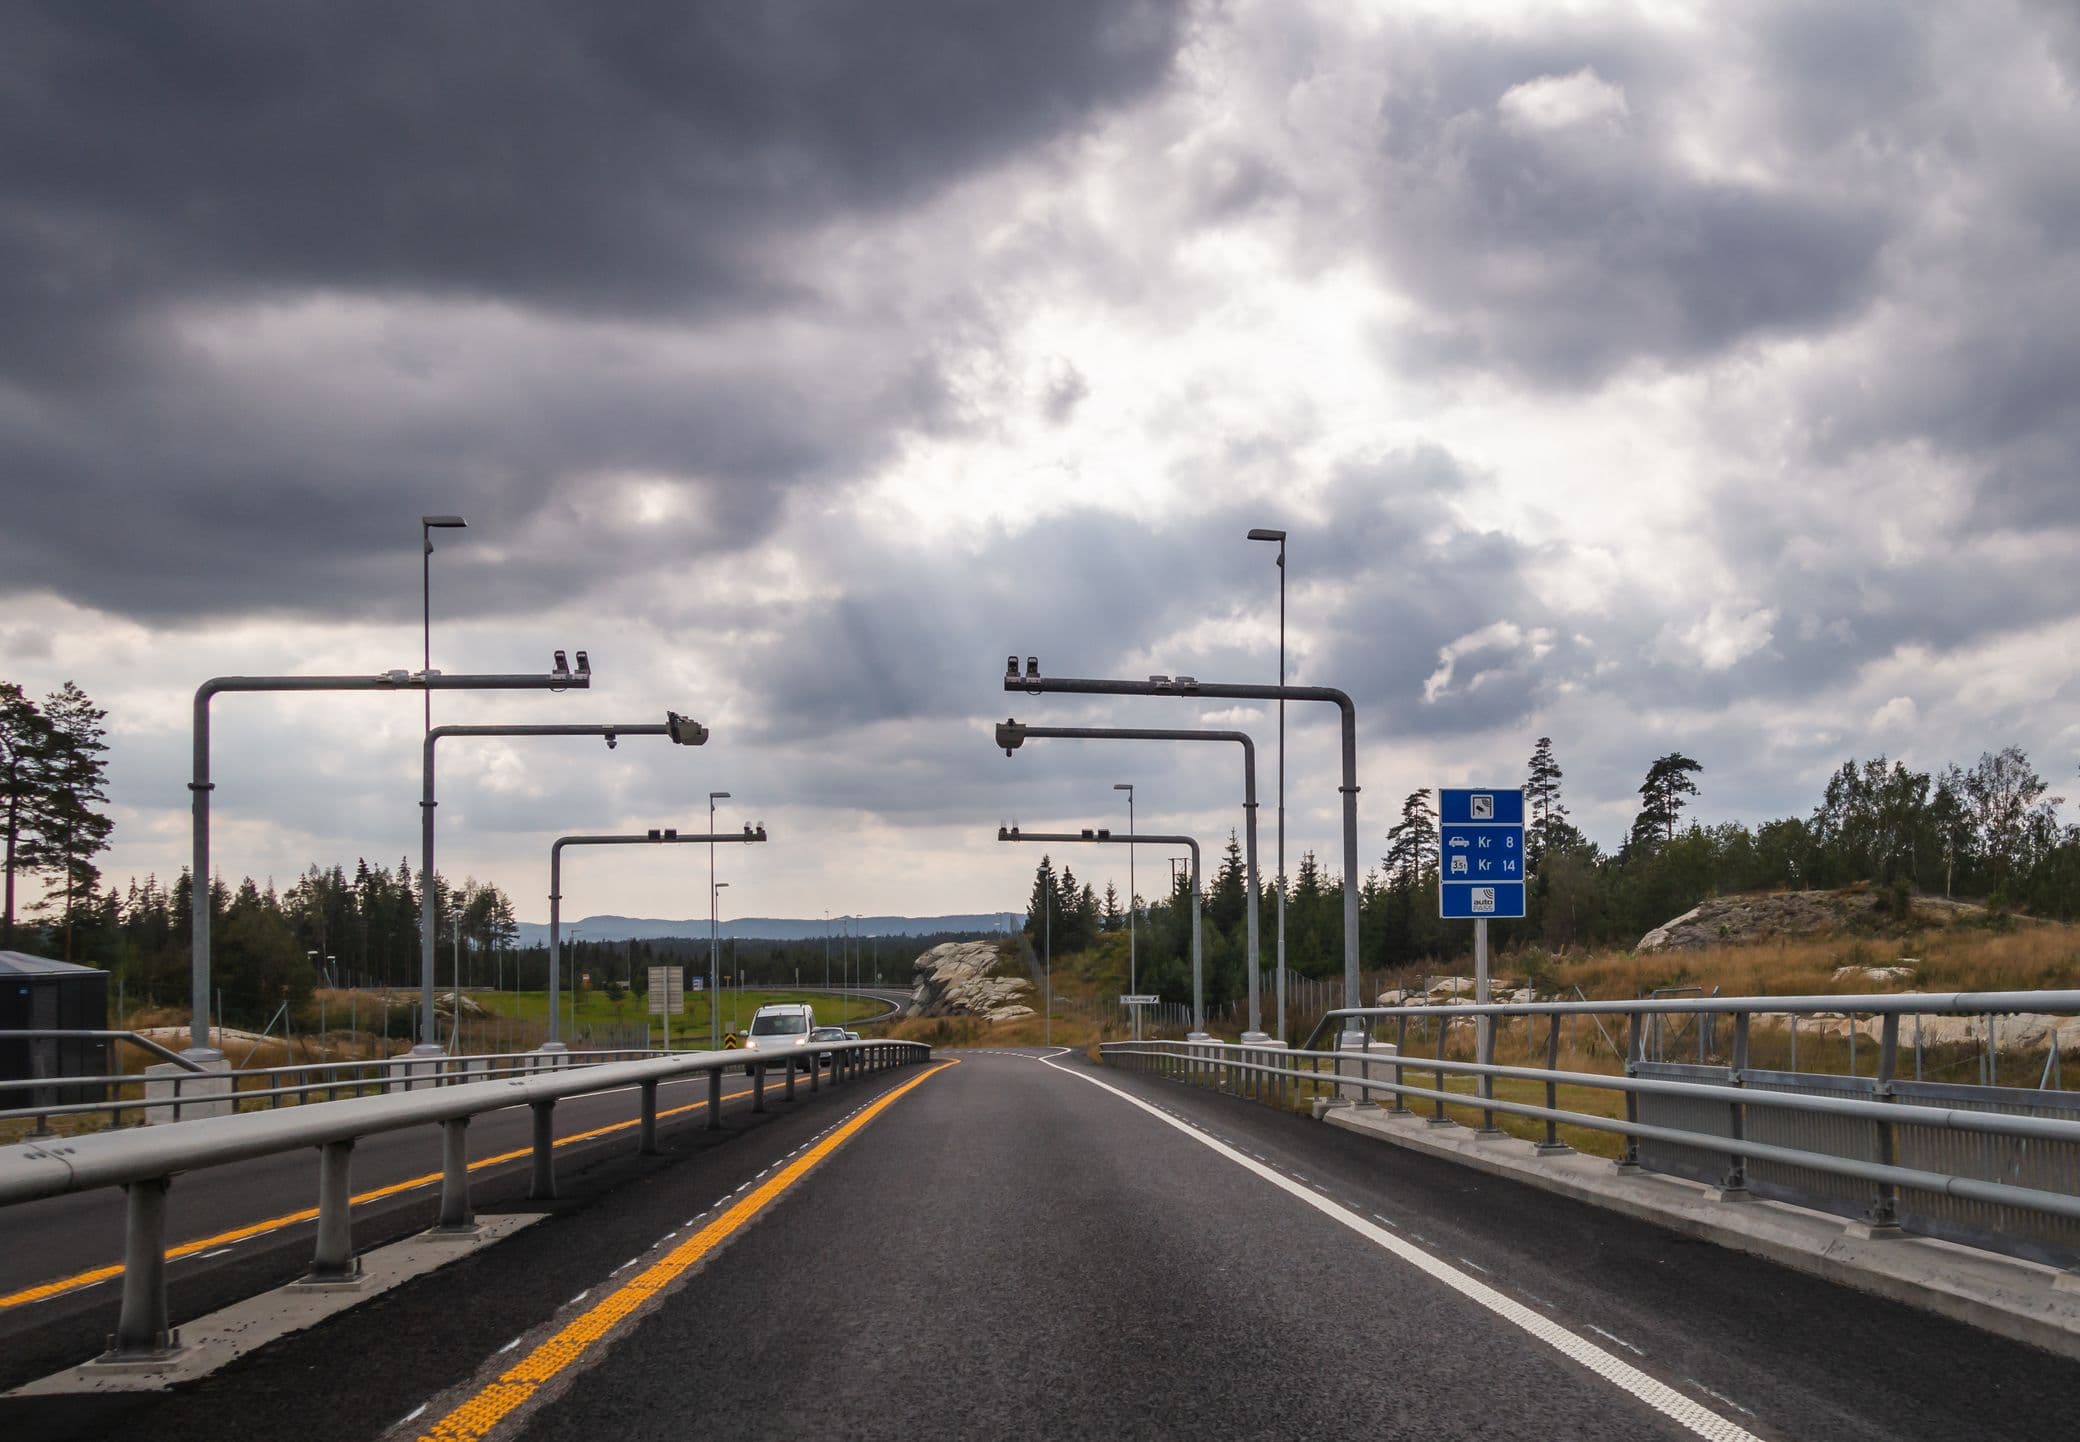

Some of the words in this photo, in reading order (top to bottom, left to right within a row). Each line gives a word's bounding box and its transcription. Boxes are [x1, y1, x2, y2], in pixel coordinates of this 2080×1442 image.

[1478, 836, 1492, 848] Kr
[1506, 836, 1514, 848] 8
[1478, 859, 1492, 871] Kr
[1502, 860, 1515, 872] 14
